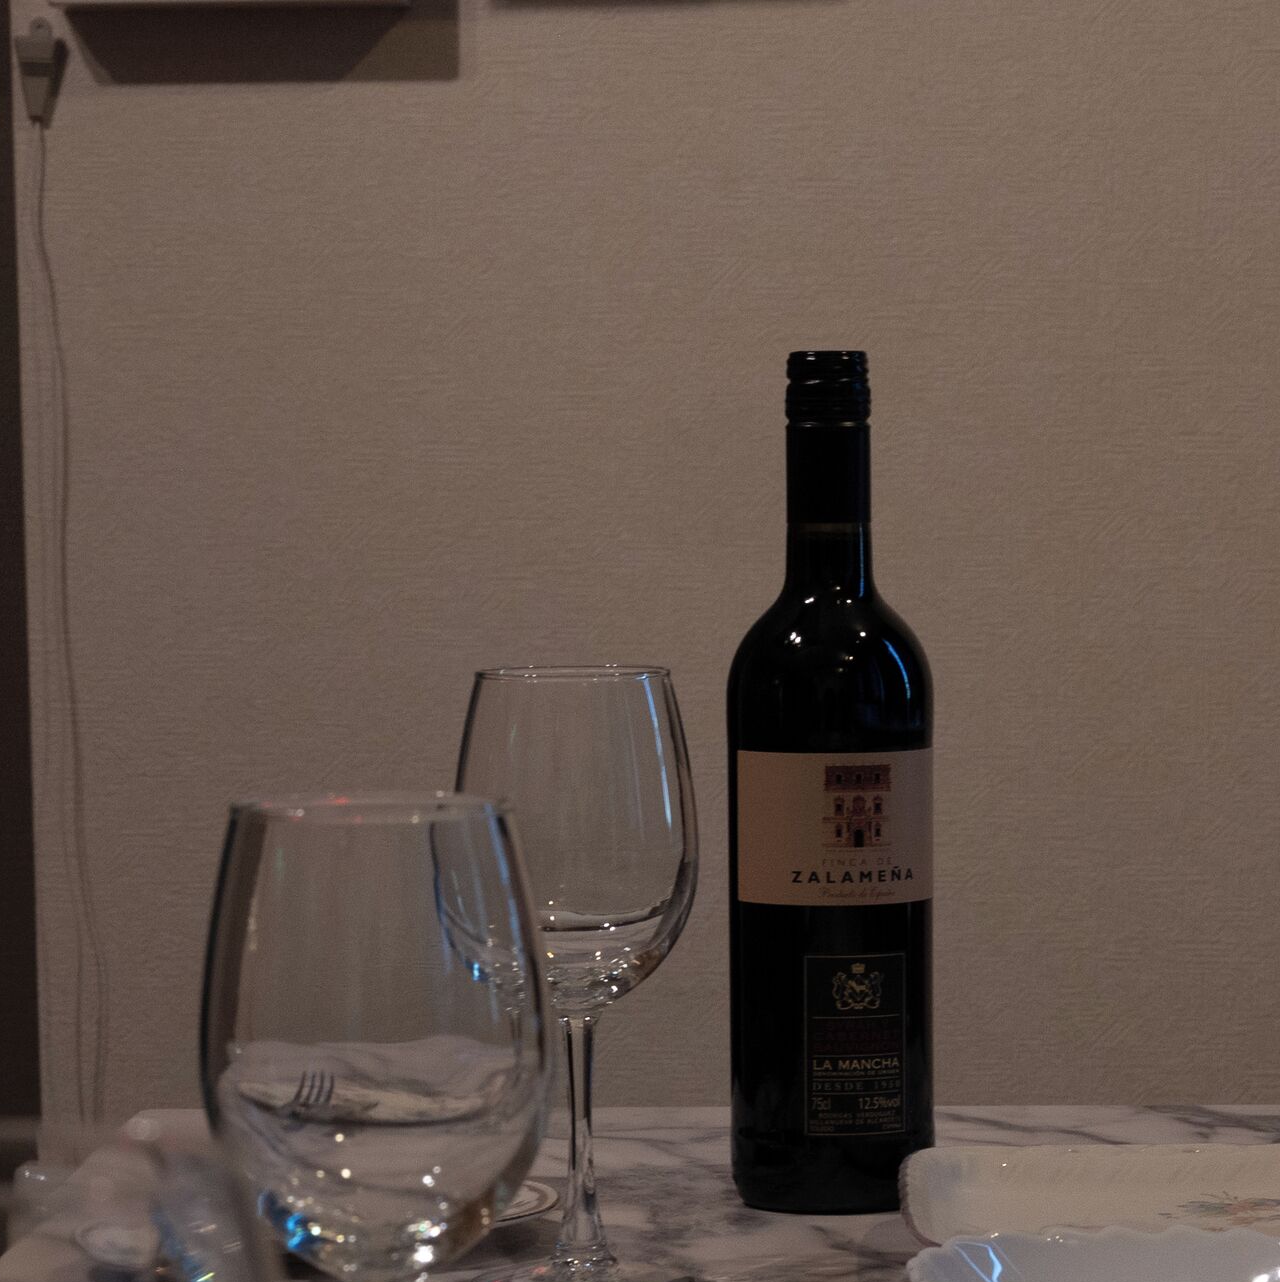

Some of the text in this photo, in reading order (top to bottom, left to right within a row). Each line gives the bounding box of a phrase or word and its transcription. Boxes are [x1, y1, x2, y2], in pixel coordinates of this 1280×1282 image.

[822, 858, 867, 867] FINCA
[792, 866, 914, 884] ZALAMEÑA
[812, 1057, 900, 1071] LA MANCHA
[812, 1081, 865, 1091] DESDE
